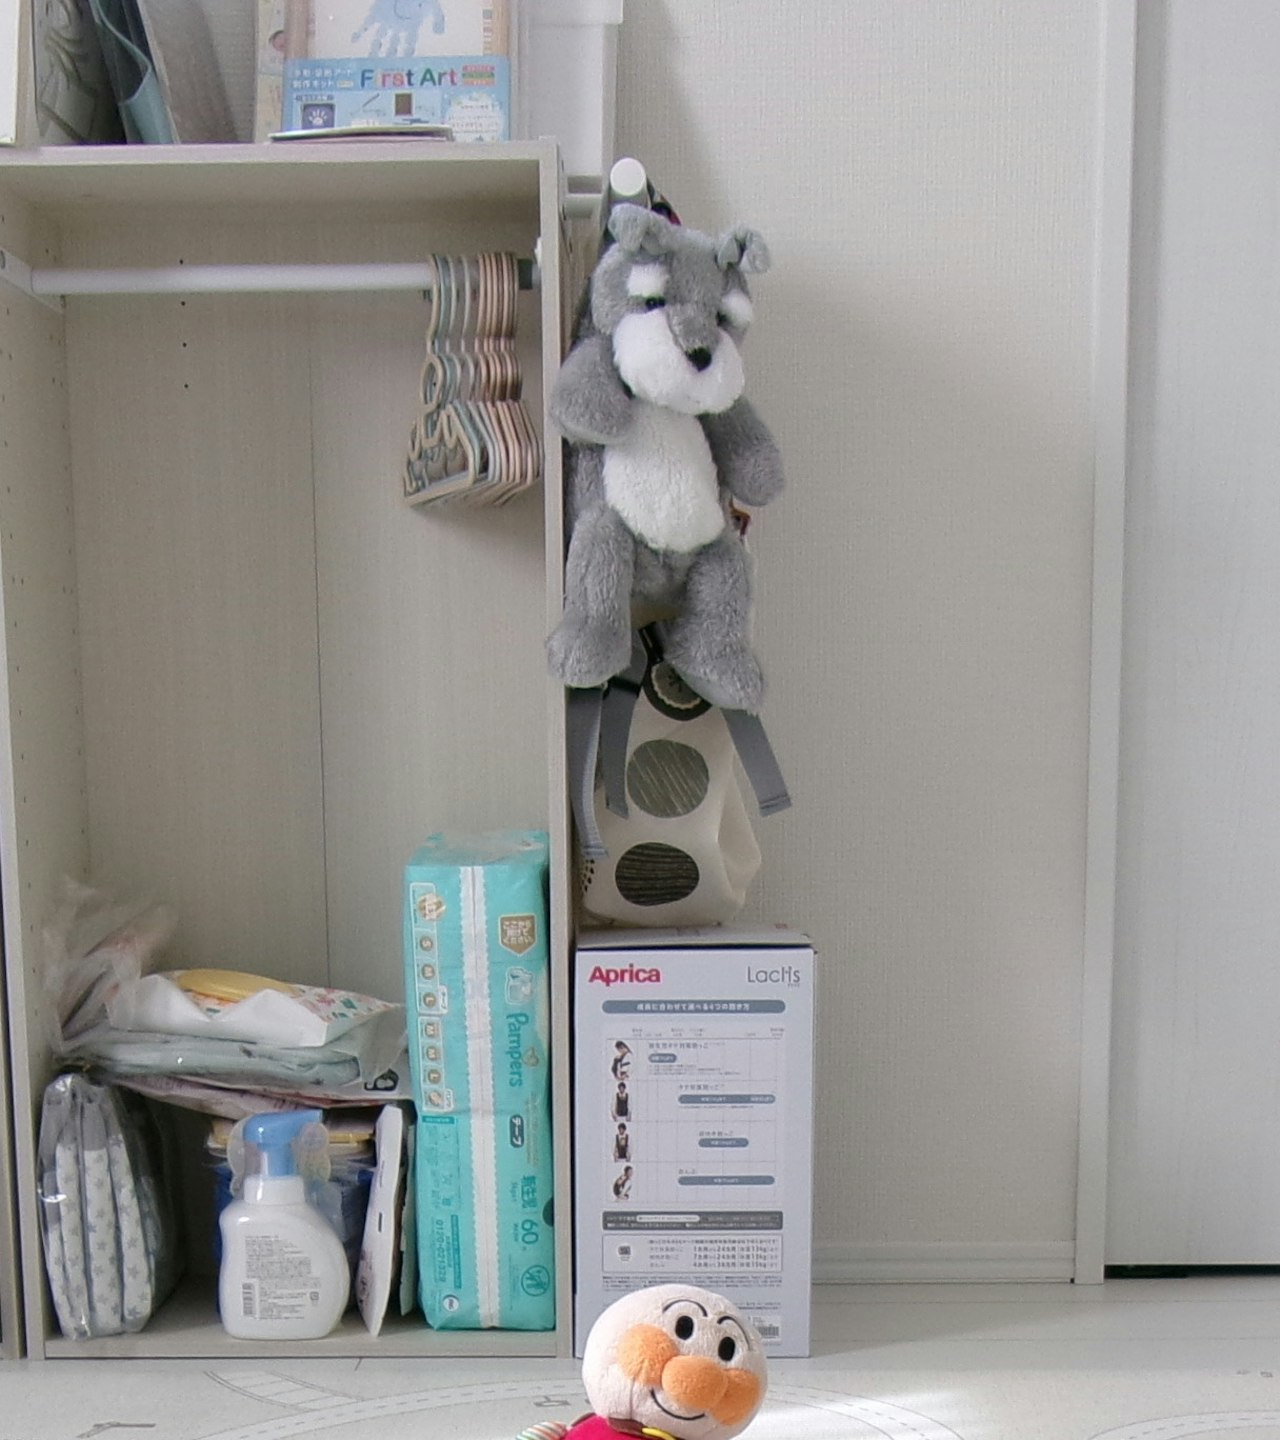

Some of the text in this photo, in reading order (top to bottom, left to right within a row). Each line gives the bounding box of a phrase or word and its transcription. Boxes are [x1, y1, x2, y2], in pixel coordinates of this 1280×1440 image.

[360, 68, 414, 89] First
[419, 67, 458, 87] Art
[588, 963, 661, 987] Aprica
[506, 1012, 529, 1088] Pampers
